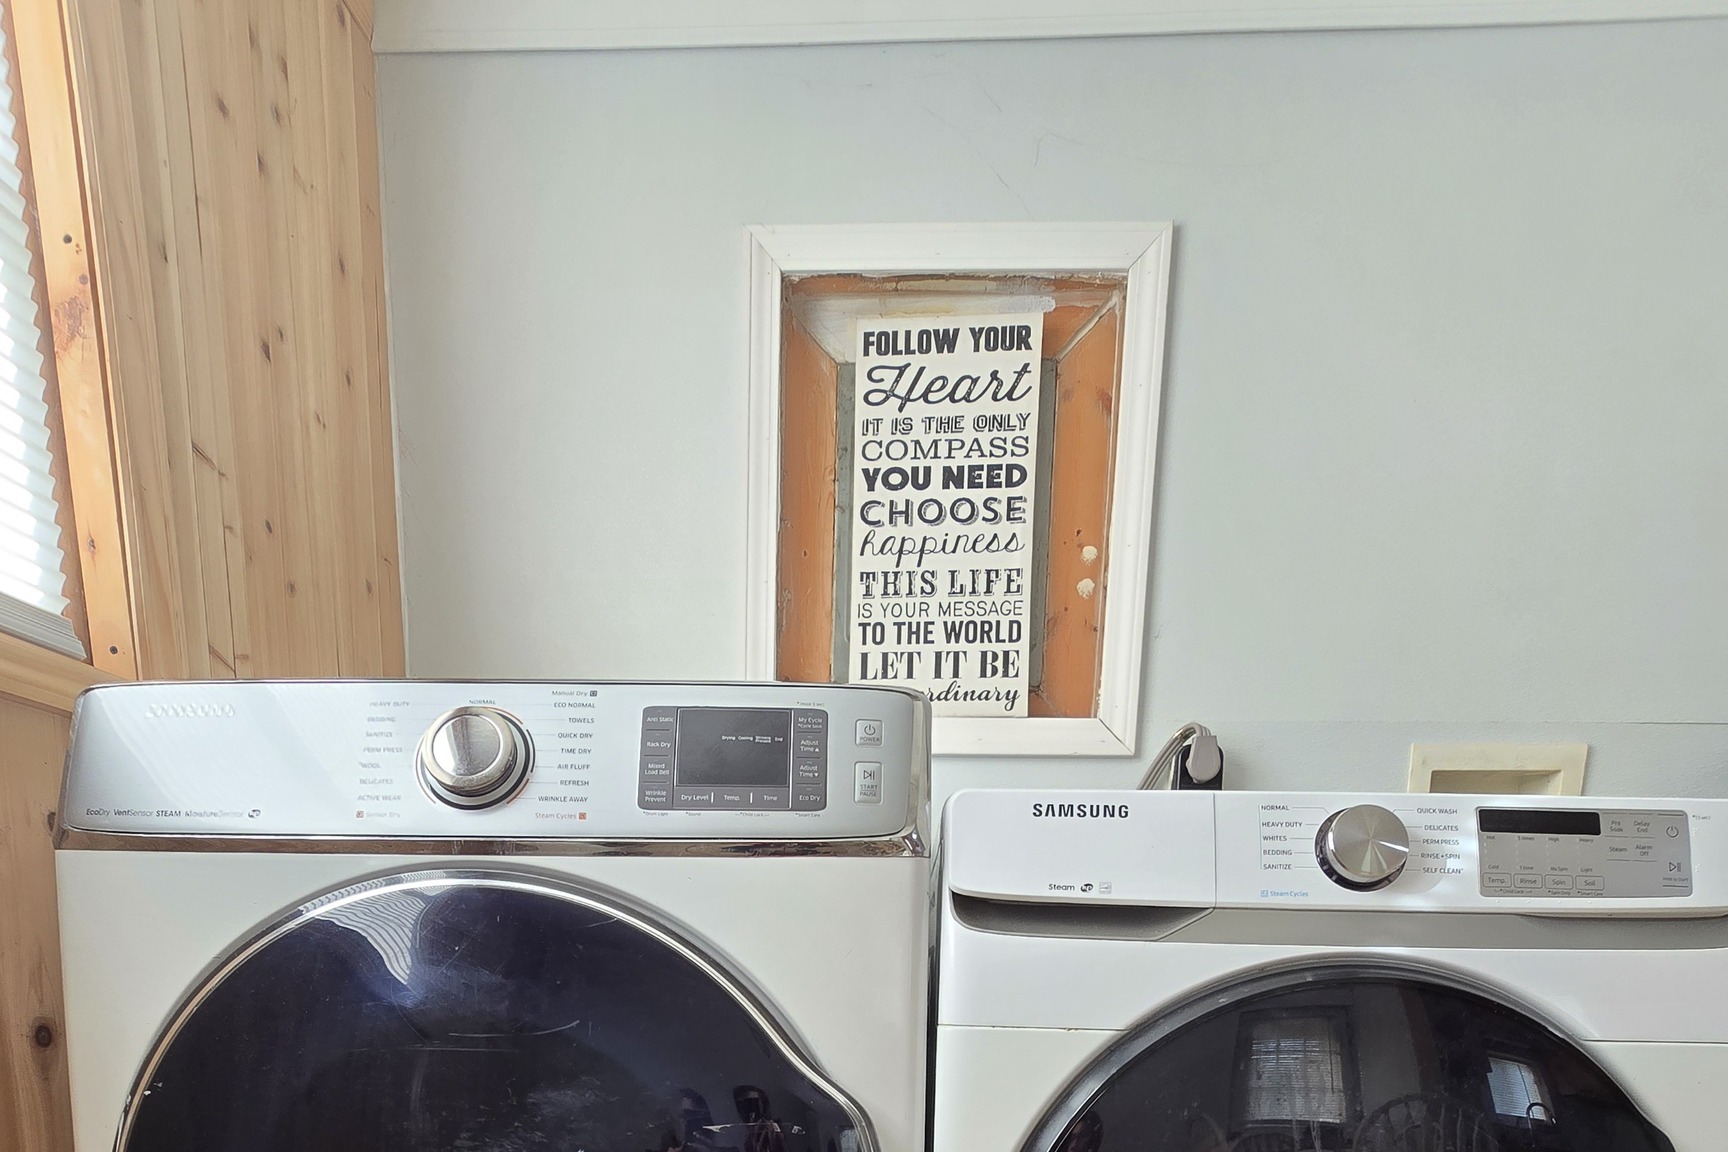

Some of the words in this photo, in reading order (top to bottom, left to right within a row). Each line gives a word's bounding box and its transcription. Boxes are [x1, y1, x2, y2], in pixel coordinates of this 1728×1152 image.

[863, 327, 960, 357] FOLLOW
[969, 325, 1032, 353] YOUR
[863, 362, 1032, 413] Heart
[862, 418, 883, 436] IT
[891, 417, 913, 435] IS
[921, 415, 964, 434] THE
[973, 412, 1031, 432] ONLY
[861, 435, 1030, 462] COMPASS
[861, 465, 931, 492] YOU
[942, 463, 1027, 490] NEED
[860, 495, 1027, 528] CHOOSE
[859, 529, 1026, 568] happiness
[859, 569, 938, 599] THIS
[947, 567, 1024, 597] LIFE
[857, 602, 873, 619] IS
[880, 601, 930, 619] YOUR
[938, 600, 1024, 617] MESSAGE
[858, 621, 885, 646] TO
[893, 621, 935, 645] THE
[943, 619, 1022, 644] WORLD
[859, 651, 921, 680] LET
[933, 650, 967, 680] IT
[978, 649, 1020, 679] BE
[660, 741, 671, 749] Dry
[86, 808, 110, 818] EcoDry
[113, 808, 154, 817] VentSensor
[155, 809, 181, 817] STEAM
[1032, 803, 1129, 819] SAMSUNG
[1048, 883, 1075, 891] Steam
[1552, 878, 1566, 886] Spin
